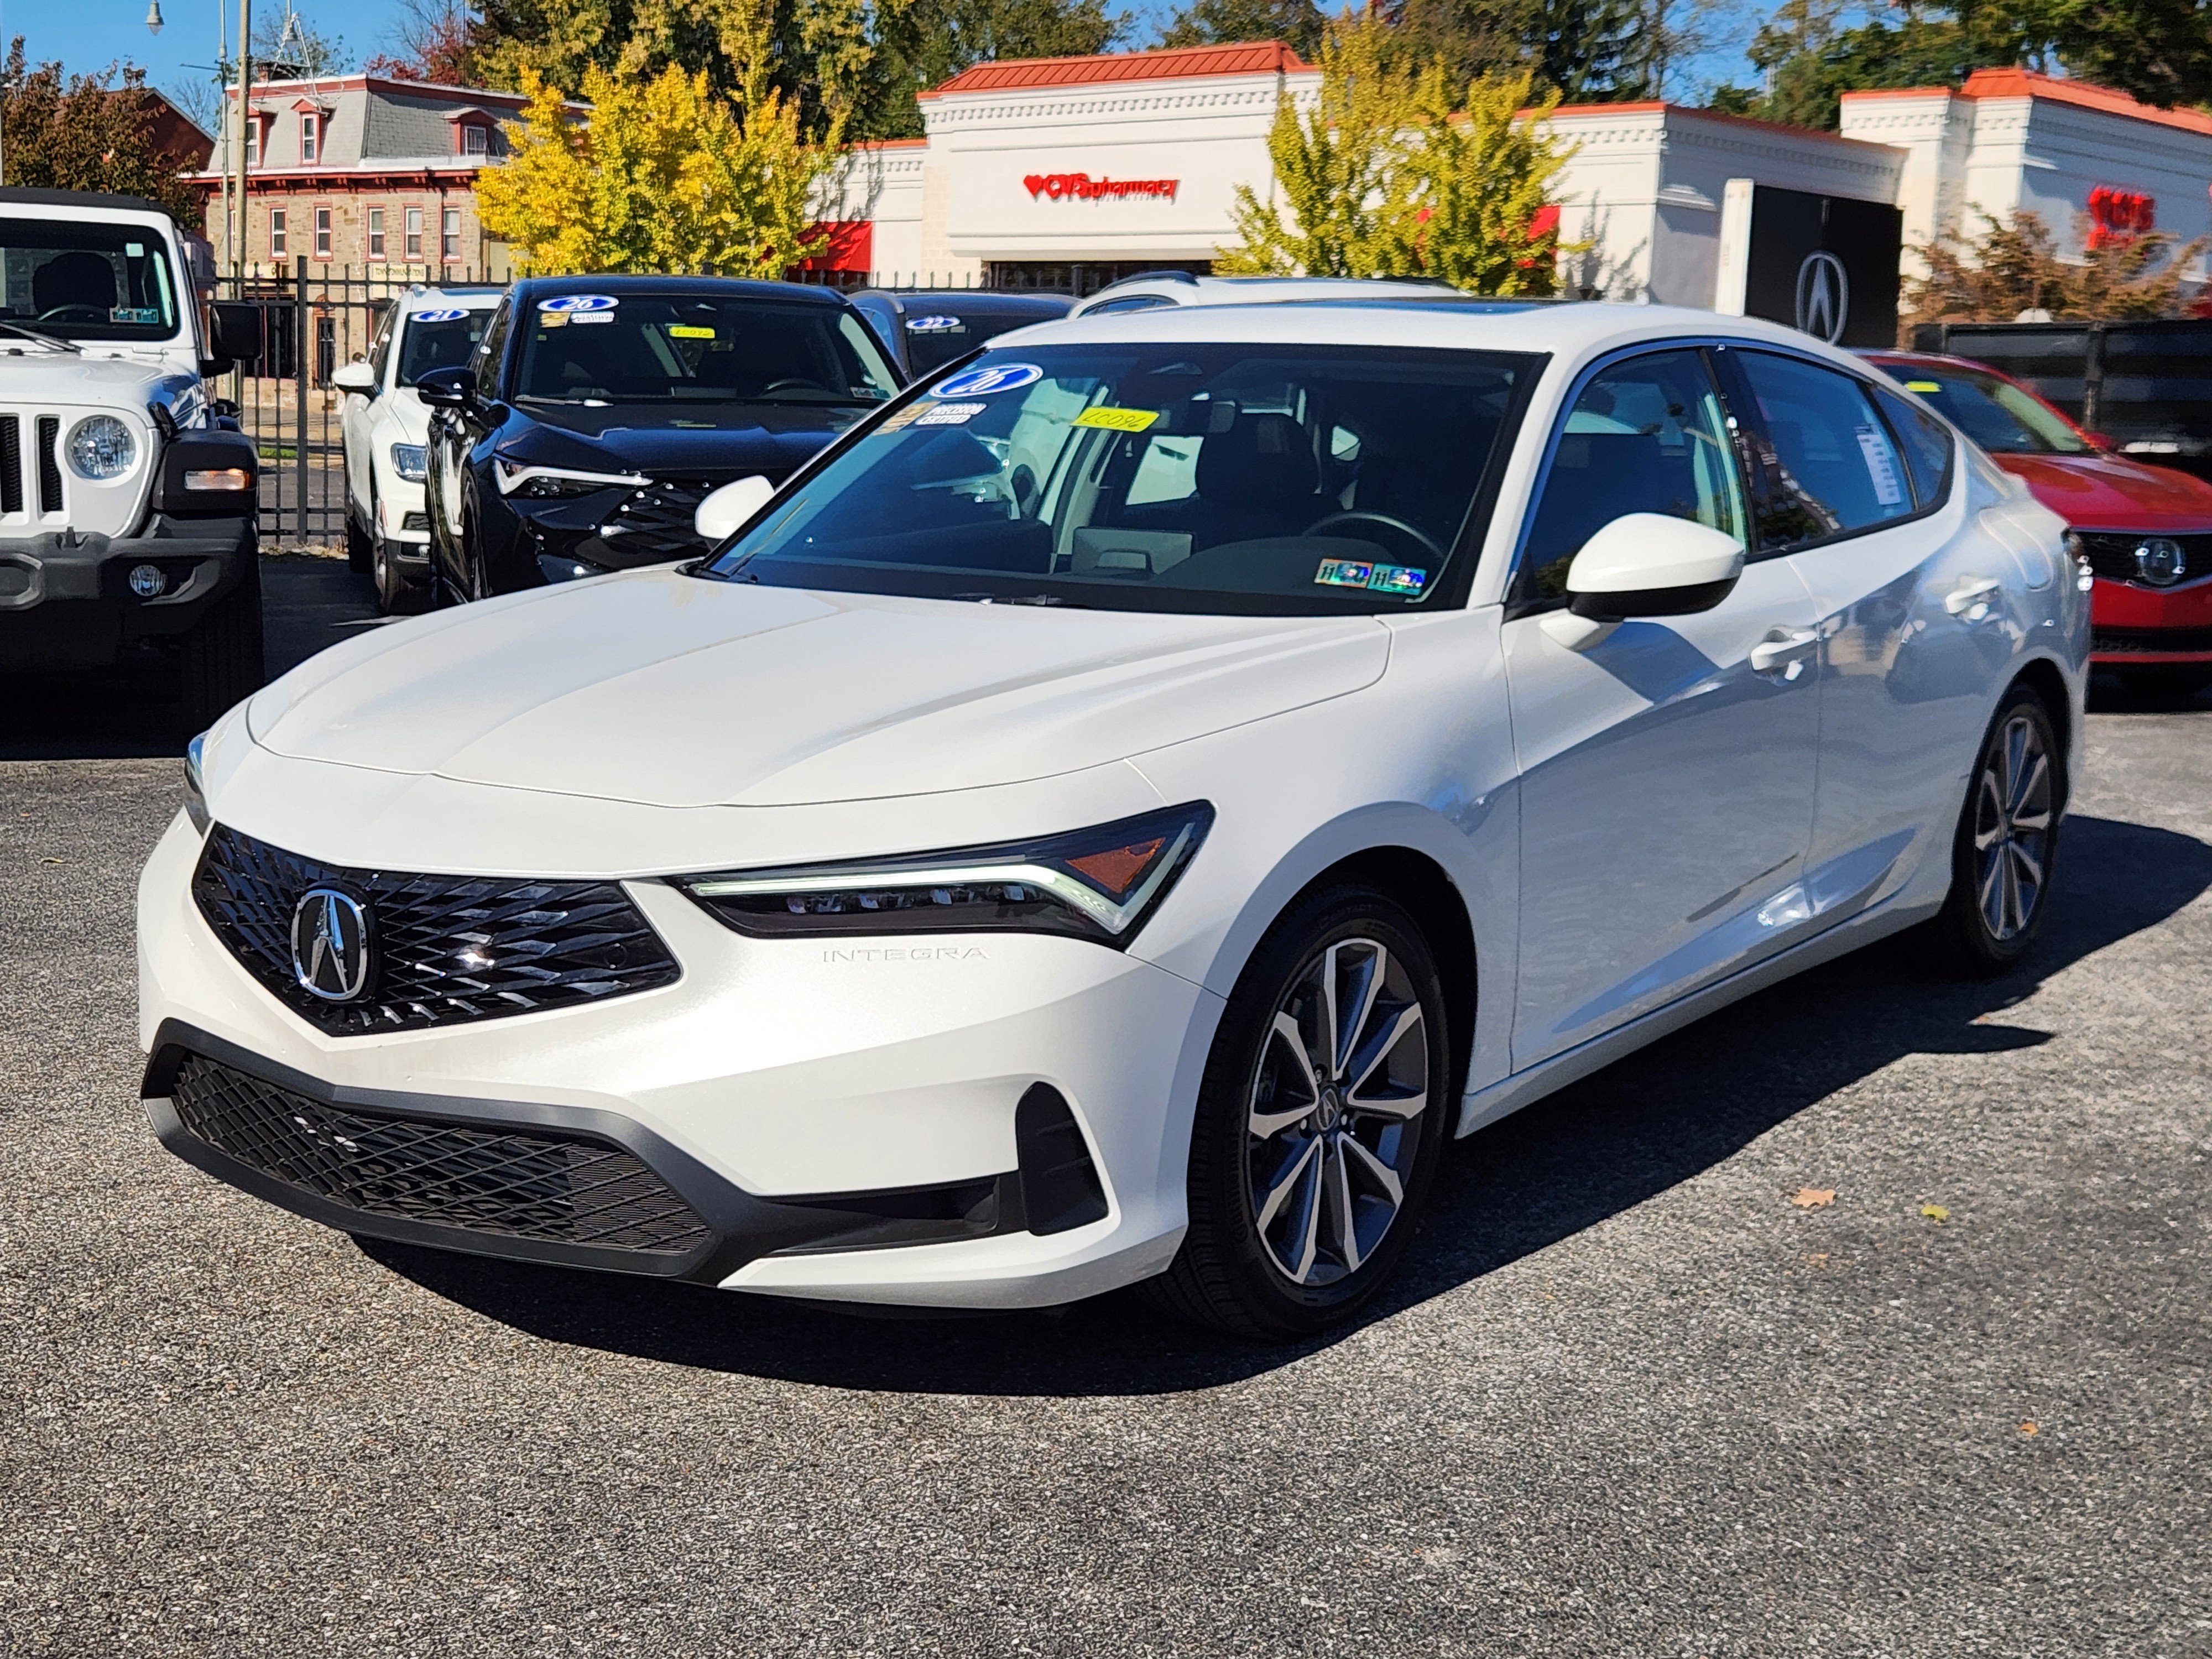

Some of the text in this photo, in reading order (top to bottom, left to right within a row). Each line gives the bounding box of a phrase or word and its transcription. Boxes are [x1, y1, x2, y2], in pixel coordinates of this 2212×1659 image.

[1089, 176, 1179, 200] pharmacy
[560, 299, 594, 310] 26
[946, 368, 1029, 394] 26
[823, 947, 991, 962] INTEGRA
